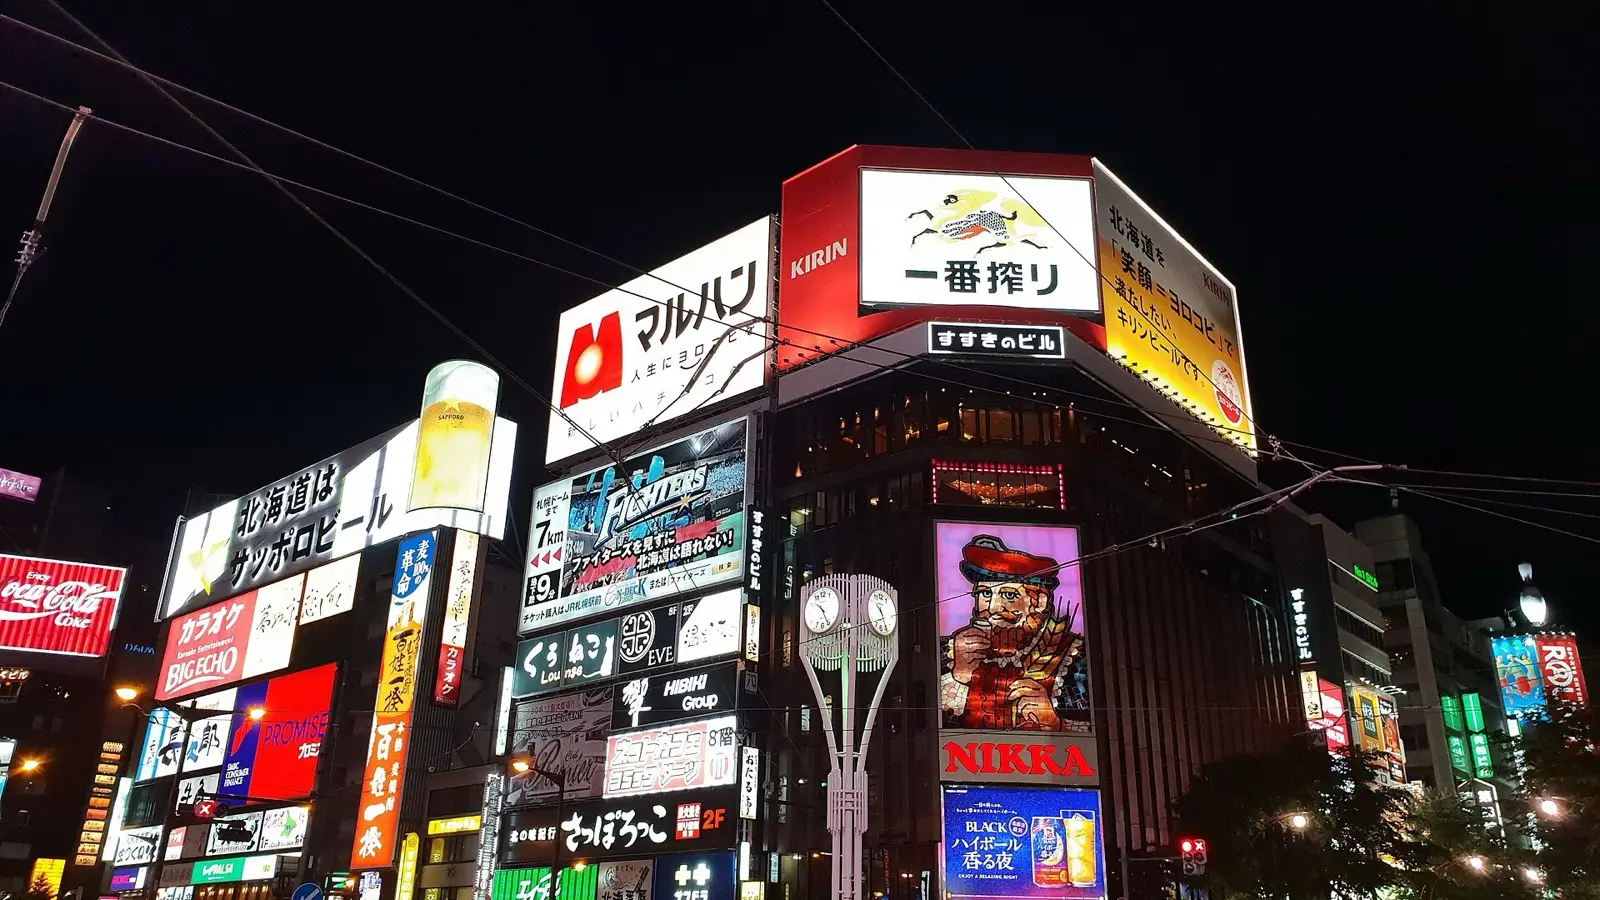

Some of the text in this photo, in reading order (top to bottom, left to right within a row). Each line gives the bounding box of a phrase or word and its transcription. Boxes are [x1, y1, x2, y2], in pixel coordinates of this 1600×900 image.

[1108, 204, 1165, 268] 北海道を
[790, 238, 848, 279] KIRIN
[905, 260, 1059, 295] 一番搾り
[1203, 272, 1230, 307] KIRIN
[635, 260, 756, 353] マルハン
[937, 330, 1056, 351] すすきのビル
[236, 463, 338, 539] 北海道は
[536, 491, 569, 510] 札幌ドーム
[545, 505, 558, 517] まで
[593, 462, 709, 551] FIGHTERS
[230, 493, 394, 588] サッポロビール
[535, 519, 564, 549] 7km
[751, 510, 764, 591] すすきのビル
[572, 531, 676, 573] ファイターズを見ずに
[397, 549, 415, 595] 革命
[649, 577, 667, 590] または
[54, 612, 92, 629] Coke
[177, 602, 245, 646] カラオケ
[164, 647, 238, 693] BIG ECHO
[442, 647, 459, 695] カラオケ
[524, 632, 600, 678] くろねこ
[648, 646, 674, 666] EVE
[540, 665, 584, 685] Lounge
[663, 674, 708, 697] HIBIKI
[682, 693, 719, 711] Group
[263, 712, 329, 748] PROMISE
[709, 727, 734, 747] 8階
[942, 741, 1095, 776] NIKKA
[510, 826, 557, 843] 北の味紀行
[561, 805, 668, 852] さっぽろっこ
[702, 808, 726, 829] 2F
[965, 821, 1008, 833] BLACK
[952, 836, 1023, 851] ハイボール
[961, 851, 1014, 870] 香る夜
